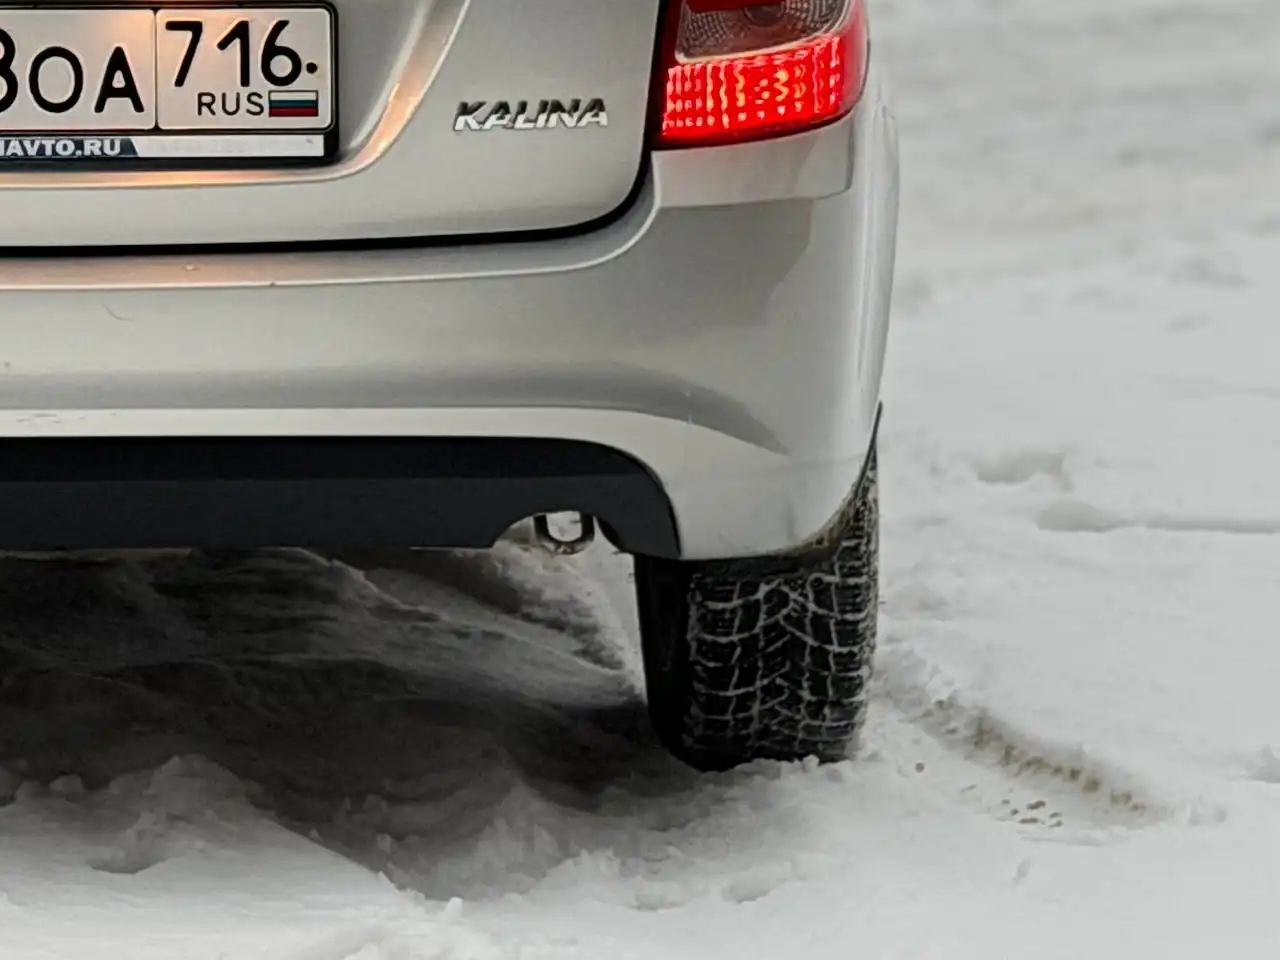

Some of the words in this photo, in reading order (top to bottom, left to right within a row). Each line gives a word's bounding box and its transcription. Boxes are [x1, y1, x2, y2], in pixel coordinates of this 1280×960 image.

[165, 19, 302, 88] 716
[197, 91, 265, 117] RUS
[453, 97, 609, 132] KALINA
